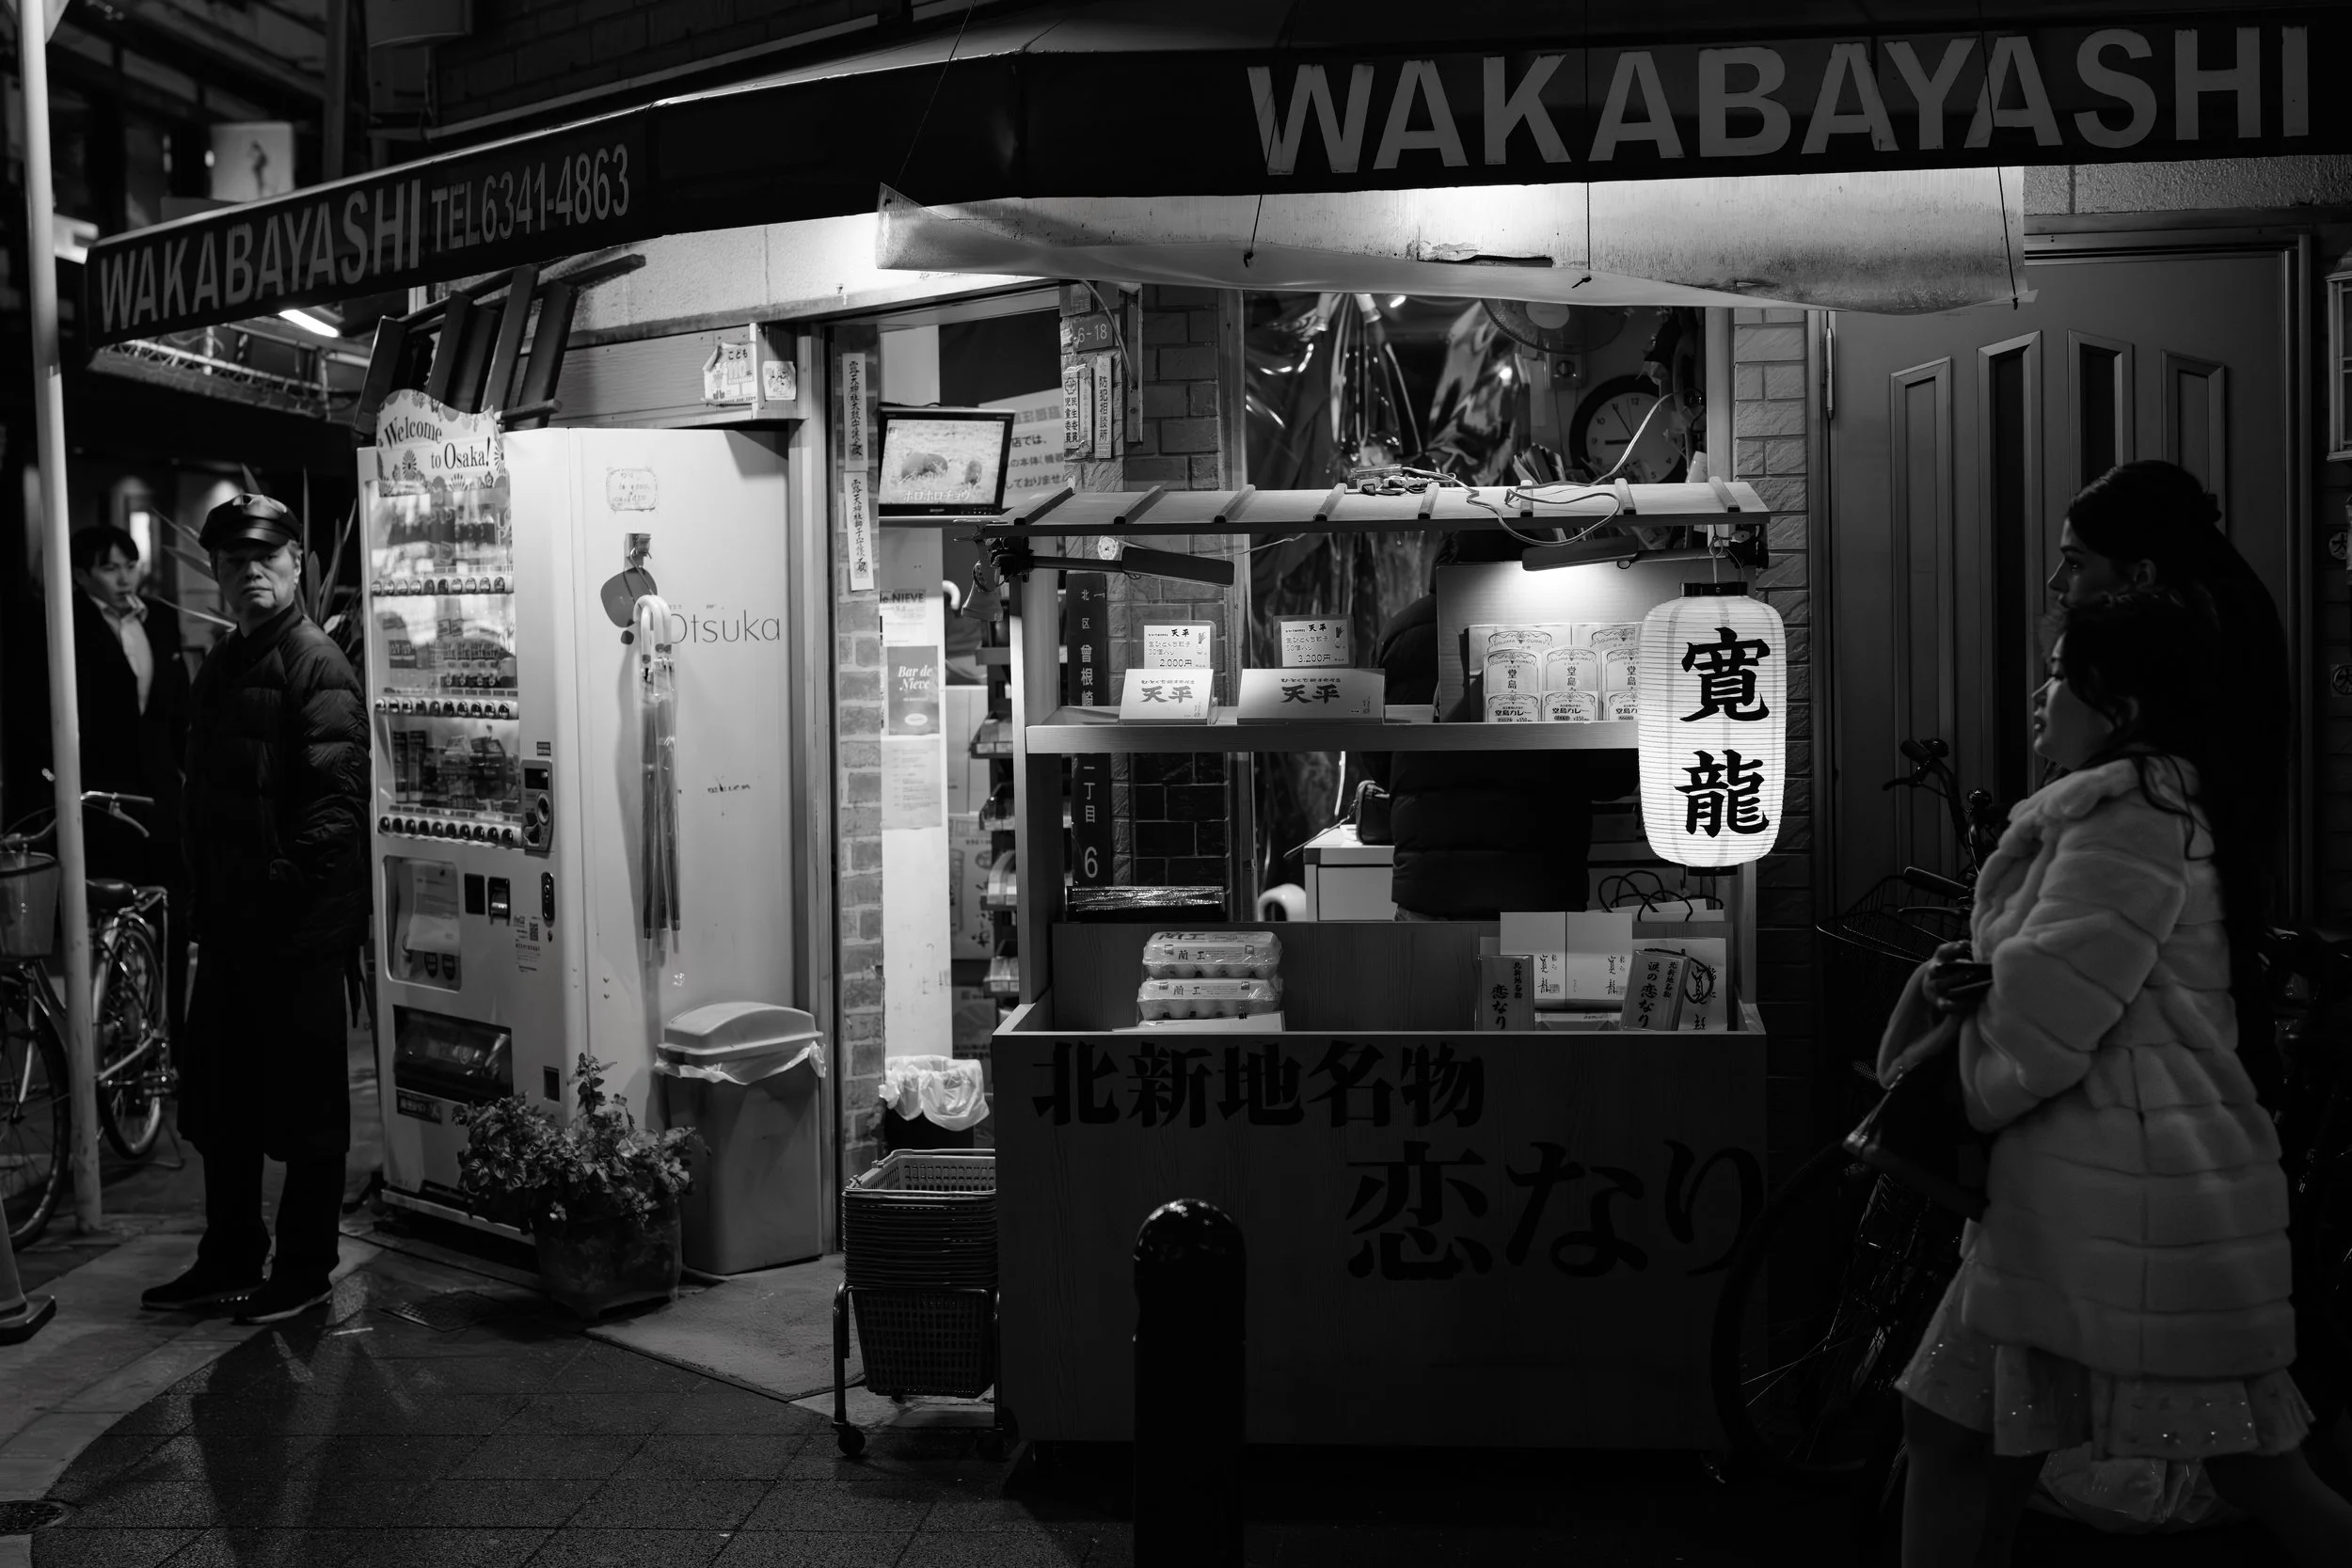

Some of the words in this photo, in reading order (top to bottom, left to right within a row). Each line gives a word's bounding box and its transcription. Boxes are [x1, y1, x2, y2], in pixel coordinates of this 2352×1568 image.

[1248, 26, 2309, 176] WAKABAYASHI
[100, 179, 421, 333] WAKABAYASHI
[1077, 323, 1107, 342] 6-18
[384, 416, 442, 450] Welcome
[431, 452, 441, 468] to
[444, 436, 491, 469] Osaka!
[892, 593, 925, 604] NIEVE
[671, 610, 781, 643] Otsuka
[1171, 628, 1189, 637] 天平
[1309, 623, 1327, 632] 天平
[898, 665, 918, 677] Bar
[920, 664, 932, 677] de
[1507, 669, 1518, 692] 堂島
[1567, 666, 1576, 690] 堂島
[1627, 666, 1636, 690] 堂島
[1140, 686, 1194, 705] 天平
[1279, 684, 1341, 705] 天平
[1084, 846, 1098, 879] 6
[1031, 1038, 1486, 1128] 北新地名物
[1345, 1139, 1764, 1281] 恋なり
